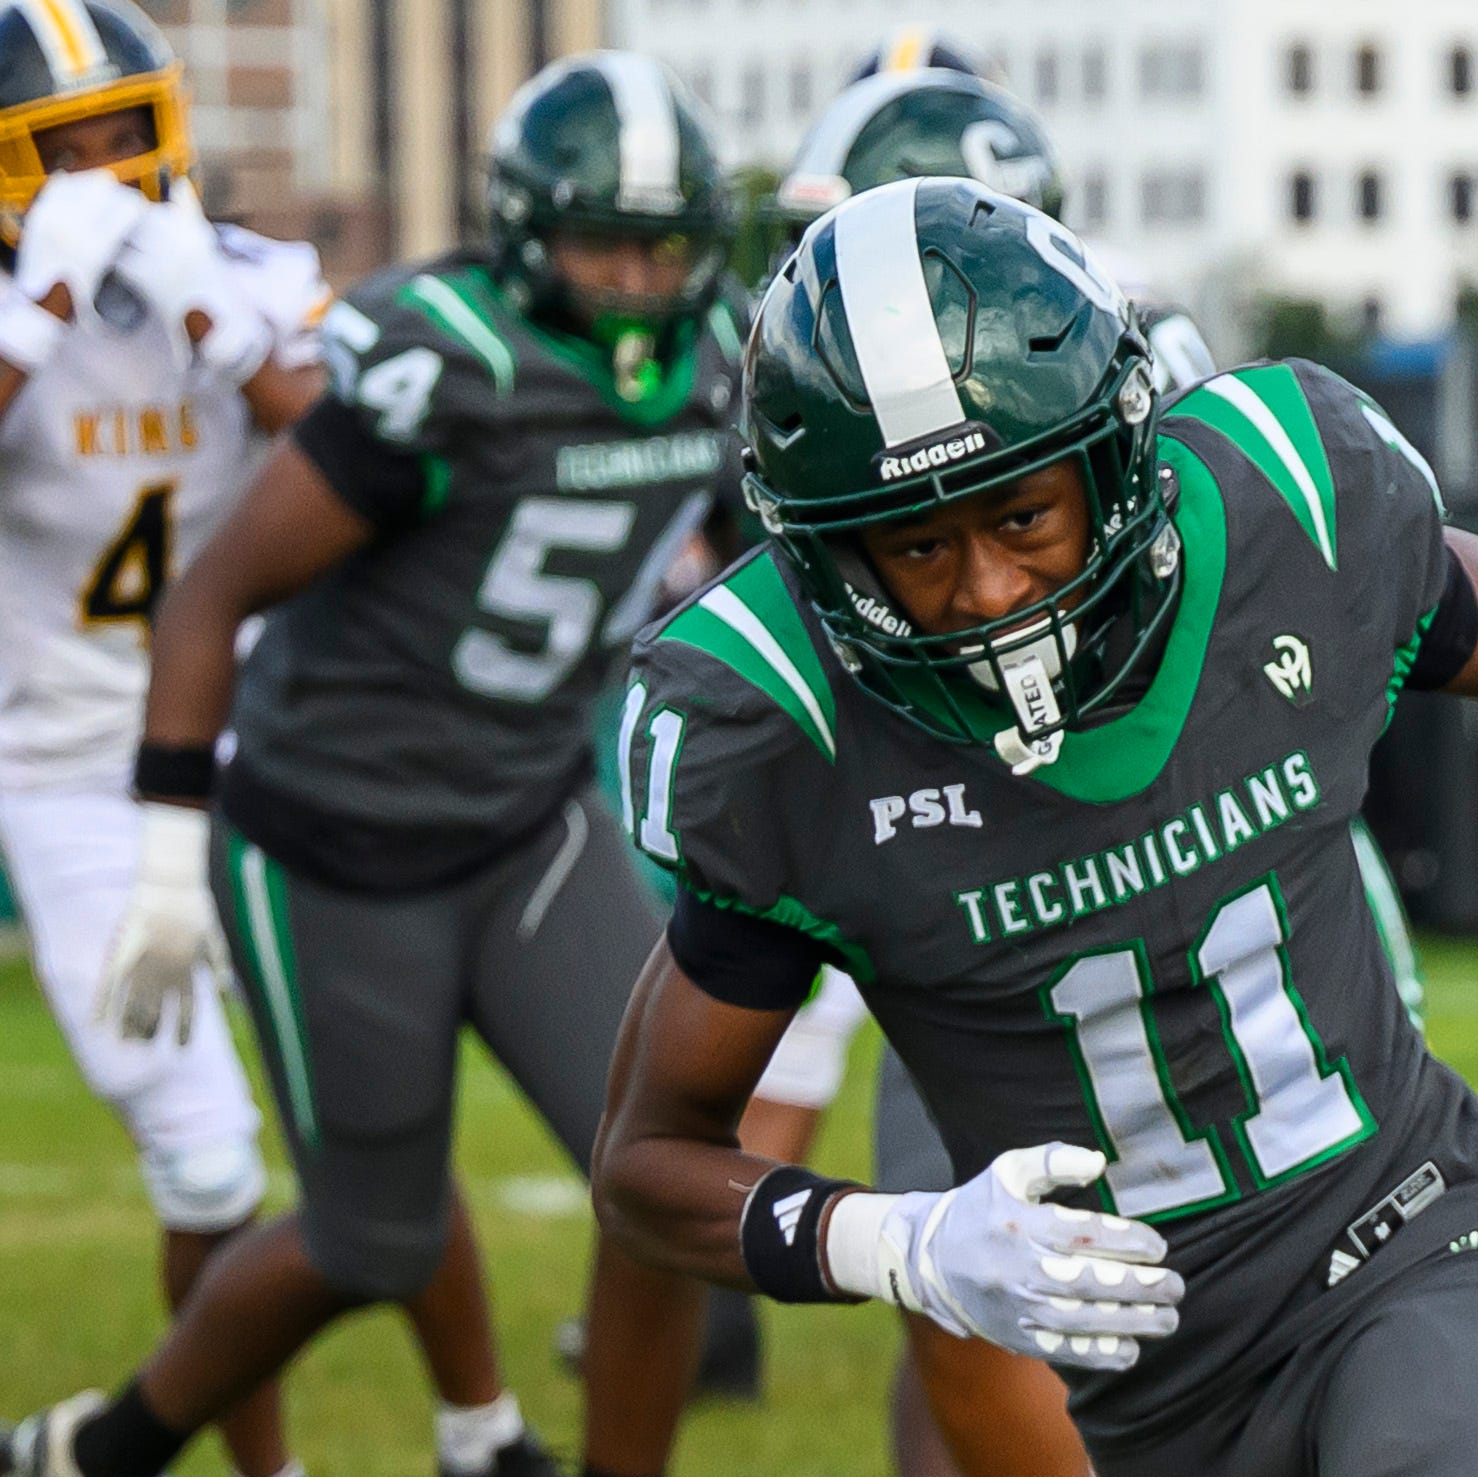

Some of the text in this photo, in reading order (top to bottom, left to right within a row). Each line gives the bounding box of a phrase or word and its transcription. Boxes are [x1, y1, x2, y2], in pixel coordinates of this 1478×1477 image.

[880, 432, 985, 481] Riddell
[869, 783, 983, 845] PSL
[954, 750, 1320, 943] TECHNICIANS
[1042, 871, 1378, 1222] 11
